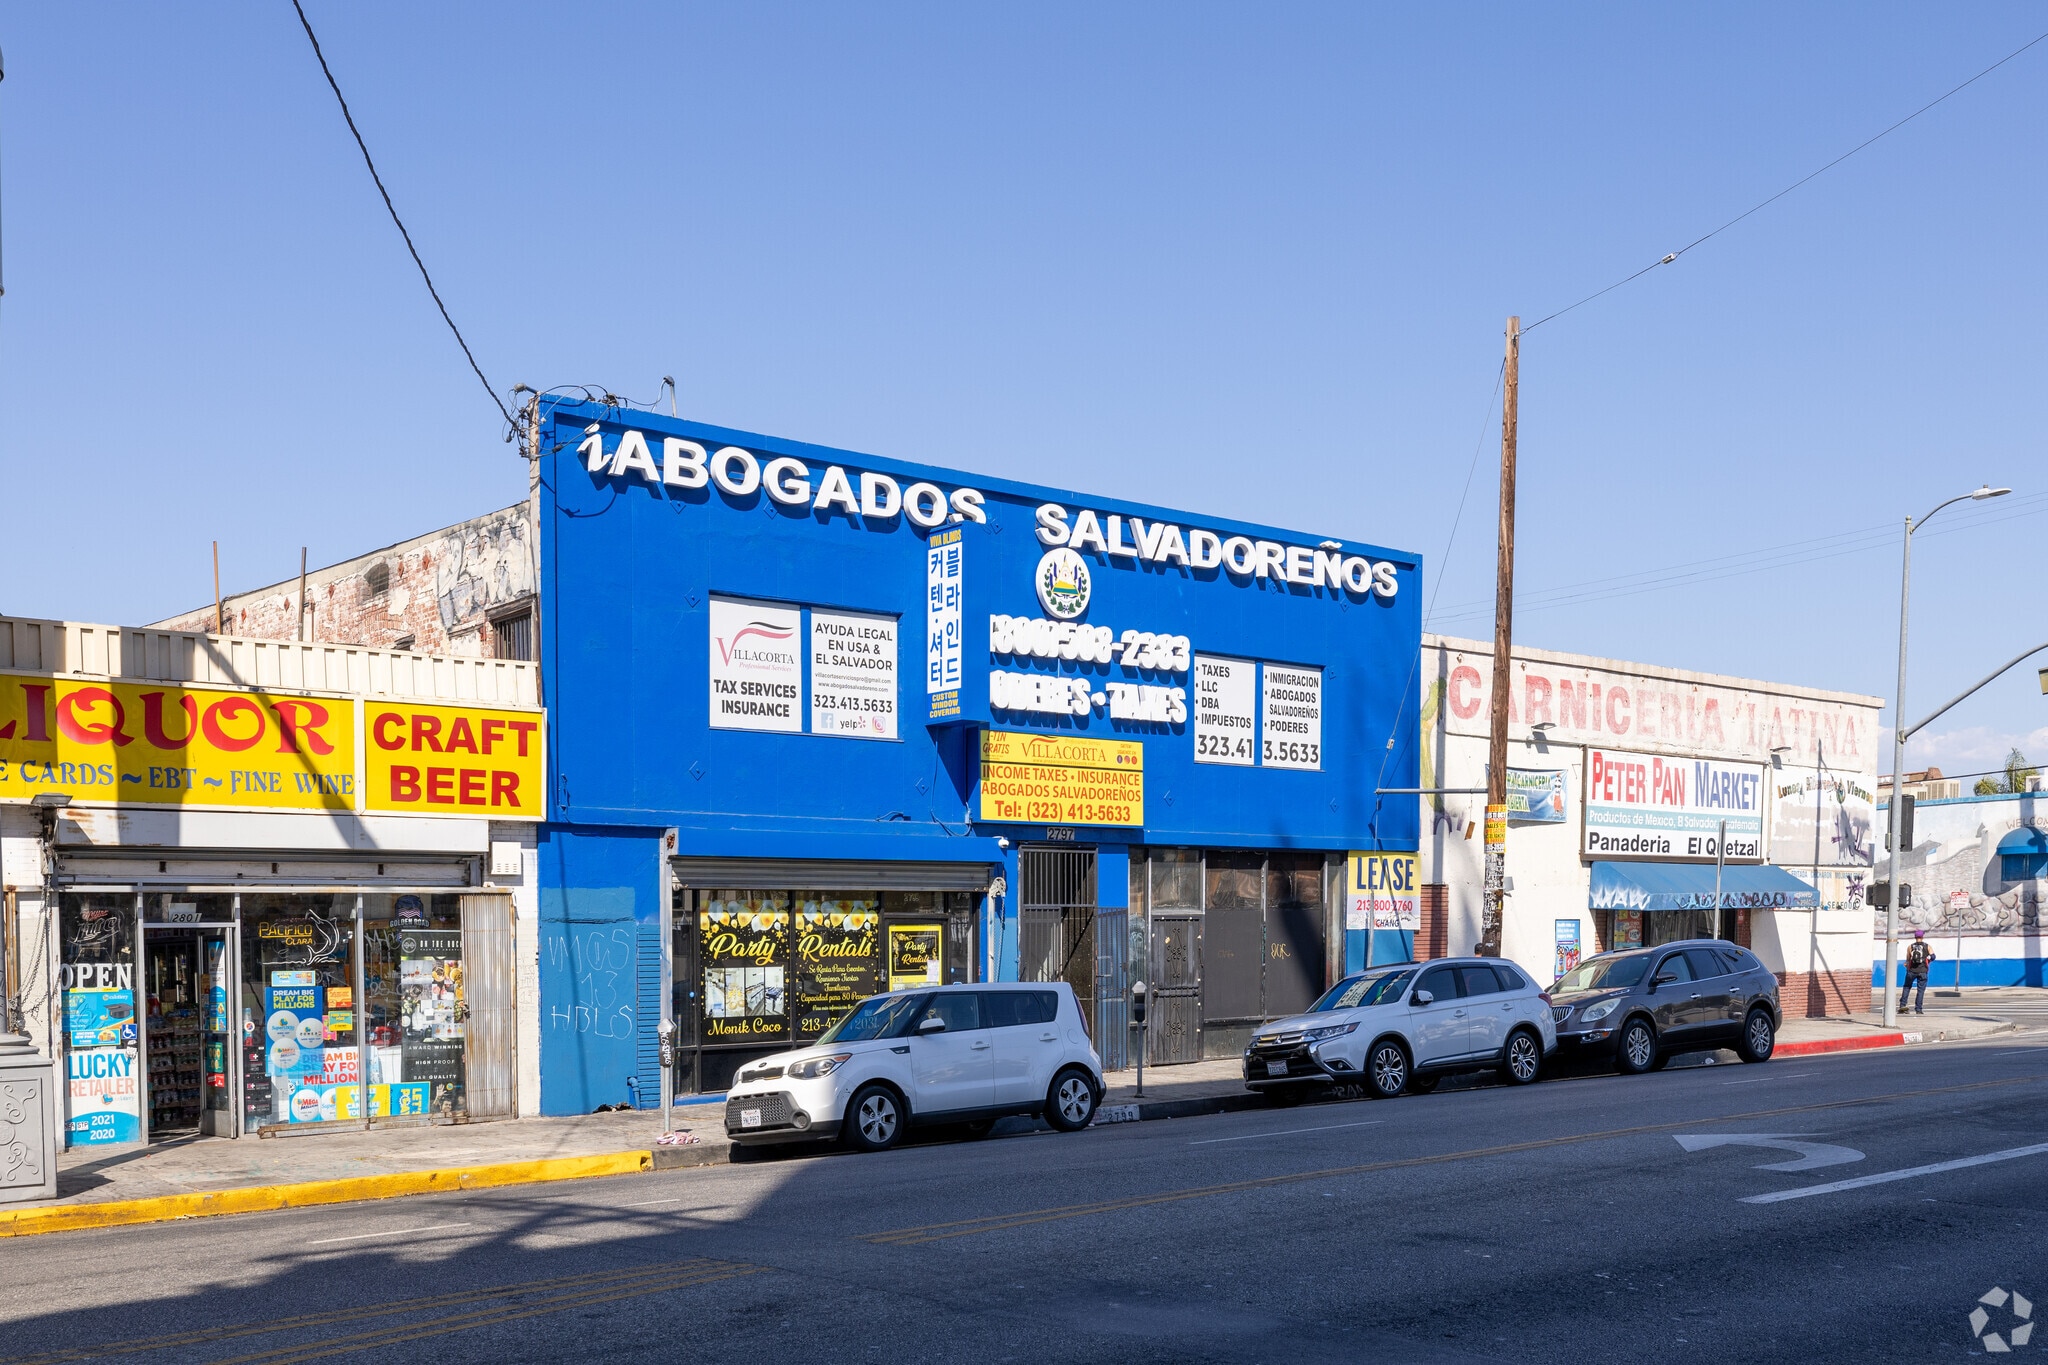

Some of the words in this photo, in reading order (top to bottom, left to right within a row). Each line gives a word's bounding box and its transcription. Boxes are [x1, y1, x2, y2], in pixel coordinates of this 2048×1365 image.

[930, 533, 942, 548] VIVA
[943, 529, 961, 545] BLINDS
[1035, 504, 1398, 597] SALVADOREÑOS
[946, 546, 960, 683] 블라인드
[815, 622, 855, 638] AYUDA
[858, 627, 893, 642] LEGAL
[828, 639, 844, 652] EN
[847, 642, 870, 655] USA
[873, 645, 881, 655] &
[739, 661, 770, 671] Professional
[771, 664, 792, 672] Services
[815, 653, 829, 665] EL
[832, 654, 893, 671] SALVADOR
[1202, 664, 1230, 678] TAXES
[1201, 680, 1218, 693] LLC
[1270, 672, 1319, 688] INMIGRACION
[714, 679, 738, 694] TAX
[741, 681, 796, 699] SERVICES
[932, 690, 958, 701] CUSTOM
[1270, 688, 1316, 703] ABOGADOS
[722, 700, 790, 718] INSURANCE
[814, 694, 893, 713] 323.413.5633
[932, 699, 958, 710] WINDOW
[1201, 697, 1219, 709] DBA
[1269, 703, 1319, 719] SALVADOREÑOS
[929, 707, 961, 718] COVERING
[840, 719, 858, 730] yelp
[1201, 713, 1252, 729] IMPUESTOS
[1270, 720, 1309, 734] PODERES
[373, 712, 537, 757] CRAFT
[983, 743, 1010, 754] GRATIS
[1021, 741, 1107, 762] VILLACORTA
[1197, 734, 1253, 759] 323.41
[1263, 740, 1319, 763] 3.5633
[20, 759, 114, 786] CARDS
[149, 766, 197, 789] EBT
[230, 770, 282, 795] FINE
[293, 772, 354, 795] WINE
[982, 765, 1031, 780] INCOME
[1033, 767, 1068, 782] TAXES
[1077, 770, 1140, 786] INSURANCE
[1591, 751, 1647, 804] PETER
[1653, 757, 1685, 806] PAN
[1695, 761, 1759, 810] MARKET
[390, 765, 521, 807] BEER
[981, 782, 1050, 798] ABOGADOS
[1052, 785, 1141, 802] SALVADOREÑOS
[995, 800, 1022, 818] Tel:
[1027, 802, 1063, 822] (323)
[1068, 803, 1131, 822] 413-5633
[1589, 809, 1632, 824] Productos
[1633, 812, 1644, 825] de
[1720, 818, 1759, 831] uatemala
[1048, 828, 1074, 840] 2797
[1589, 831, 1671, 853] Panaderia
[1687, 836, 1702, 855] El
[1706, 837, 1758, 856] Qetzal
[1357, 857, 1413, 891] LEASE
[172, 913, 200, 922] 2801
[390, 918, 412, 927] GOLDEN
[414, 918, 430, 927] ROAD
[259, 921, 313, 937] PACIFICO
[285, 937, 313, 945] CLARA
[709, 933, 779, 965] Party
[798, 933, 873, 964] Rentals
[904, 941, 927, 954] Party
[61, 963, 132, 991] OPEN
[273, 989, 300, 997] DREAM
[273, 995, 296, 1003] PLAY
[800, 993, 829, 1004] Capacidad
[851, 992, 873, 1000] Persona
[273, 1001, 315, 1010] MILLIONS
[708, 1021, 750, 1036] Monik
[752, 1018, 782, 1033] Coco
[346, 1052, 358, 1061] BI
[68, 1053, 131, 1079] LUCKY
[340, 1062, 358, 1072] FO
[303, 1073, 358, 1086] MILLION
[68, 1078, 134, 1098] RETAILER
[91, 1114, 115, 1126] 2021
[1107, 1111, 1134, 1122] 2799
[90, 1128, 115, 1140] 2020
